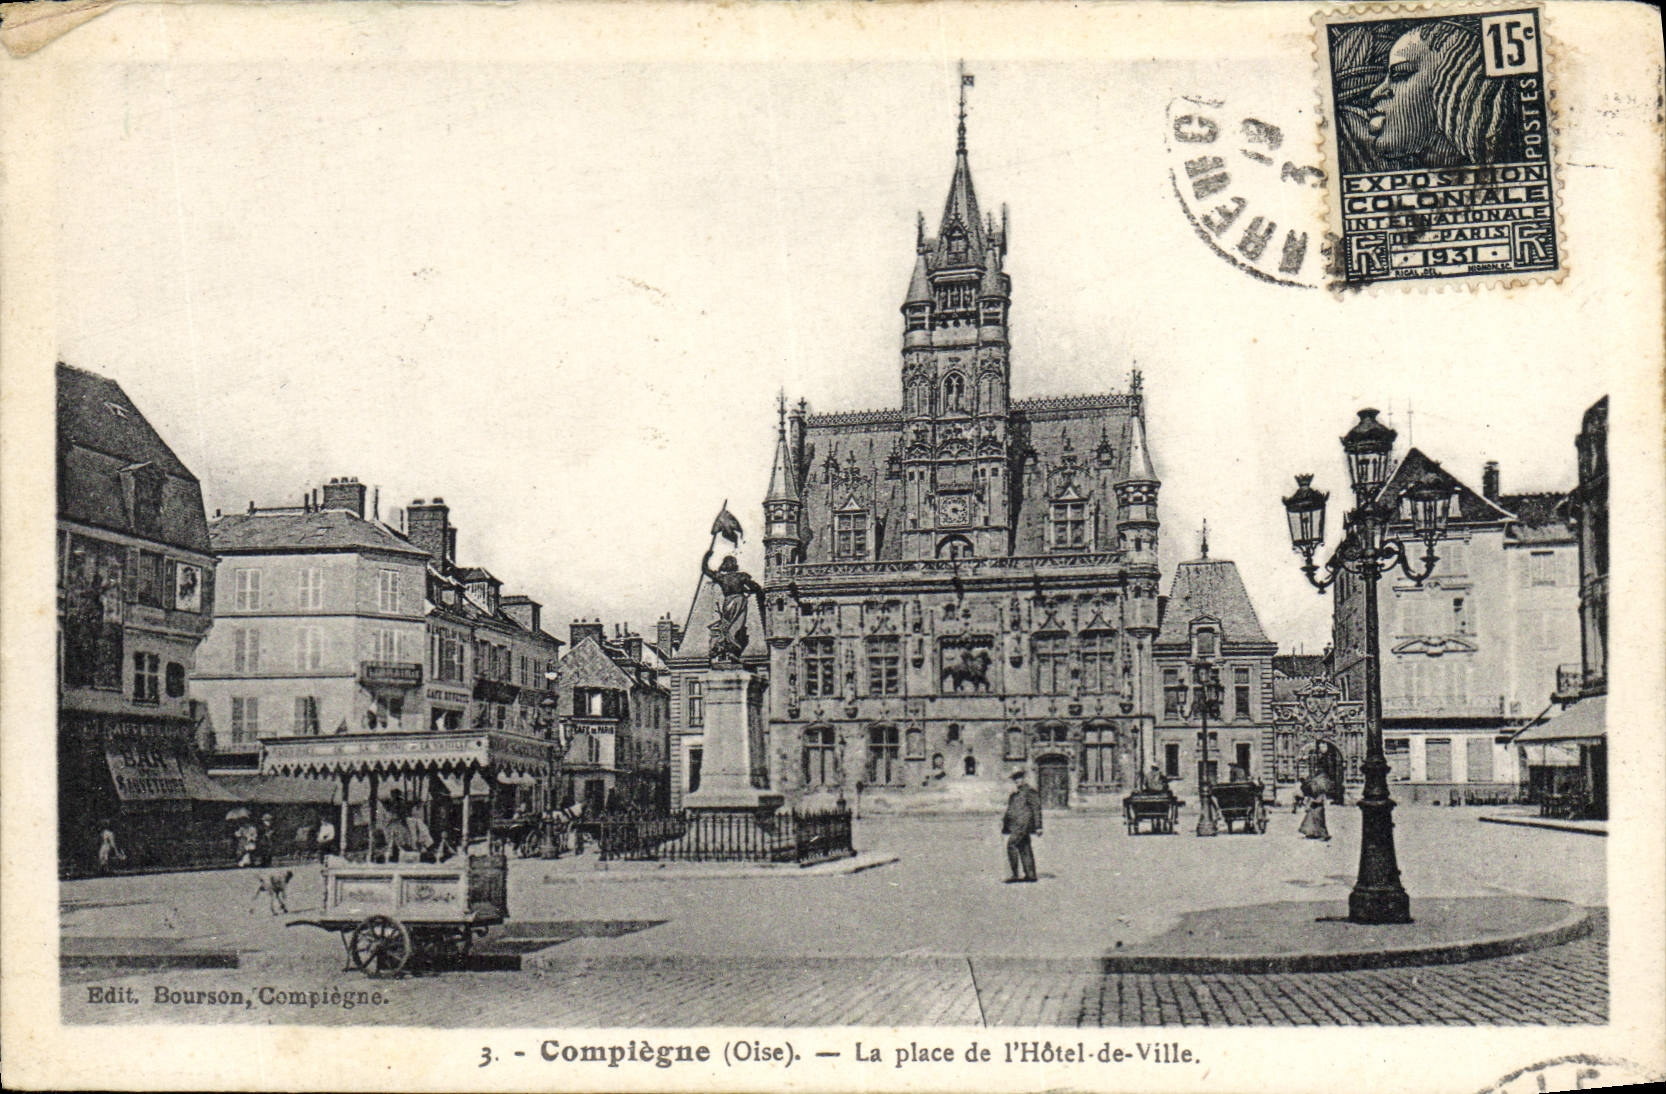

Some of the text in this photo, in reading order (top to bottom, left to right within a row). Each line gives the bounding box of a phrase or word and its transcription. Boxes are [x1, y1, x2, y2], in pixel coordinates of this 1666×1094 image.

[1521, 78, 1543, 160] POSTES
[1345, 166, 1546, 193] EXPOSITION
[1347, 185, 1549, 213] COLONIALE
[1346, 207, 1549, 231] INTERNATIONALE
[1441, 226, 1508, 242] PARIS
[123, 749, 168, 769] BAR
